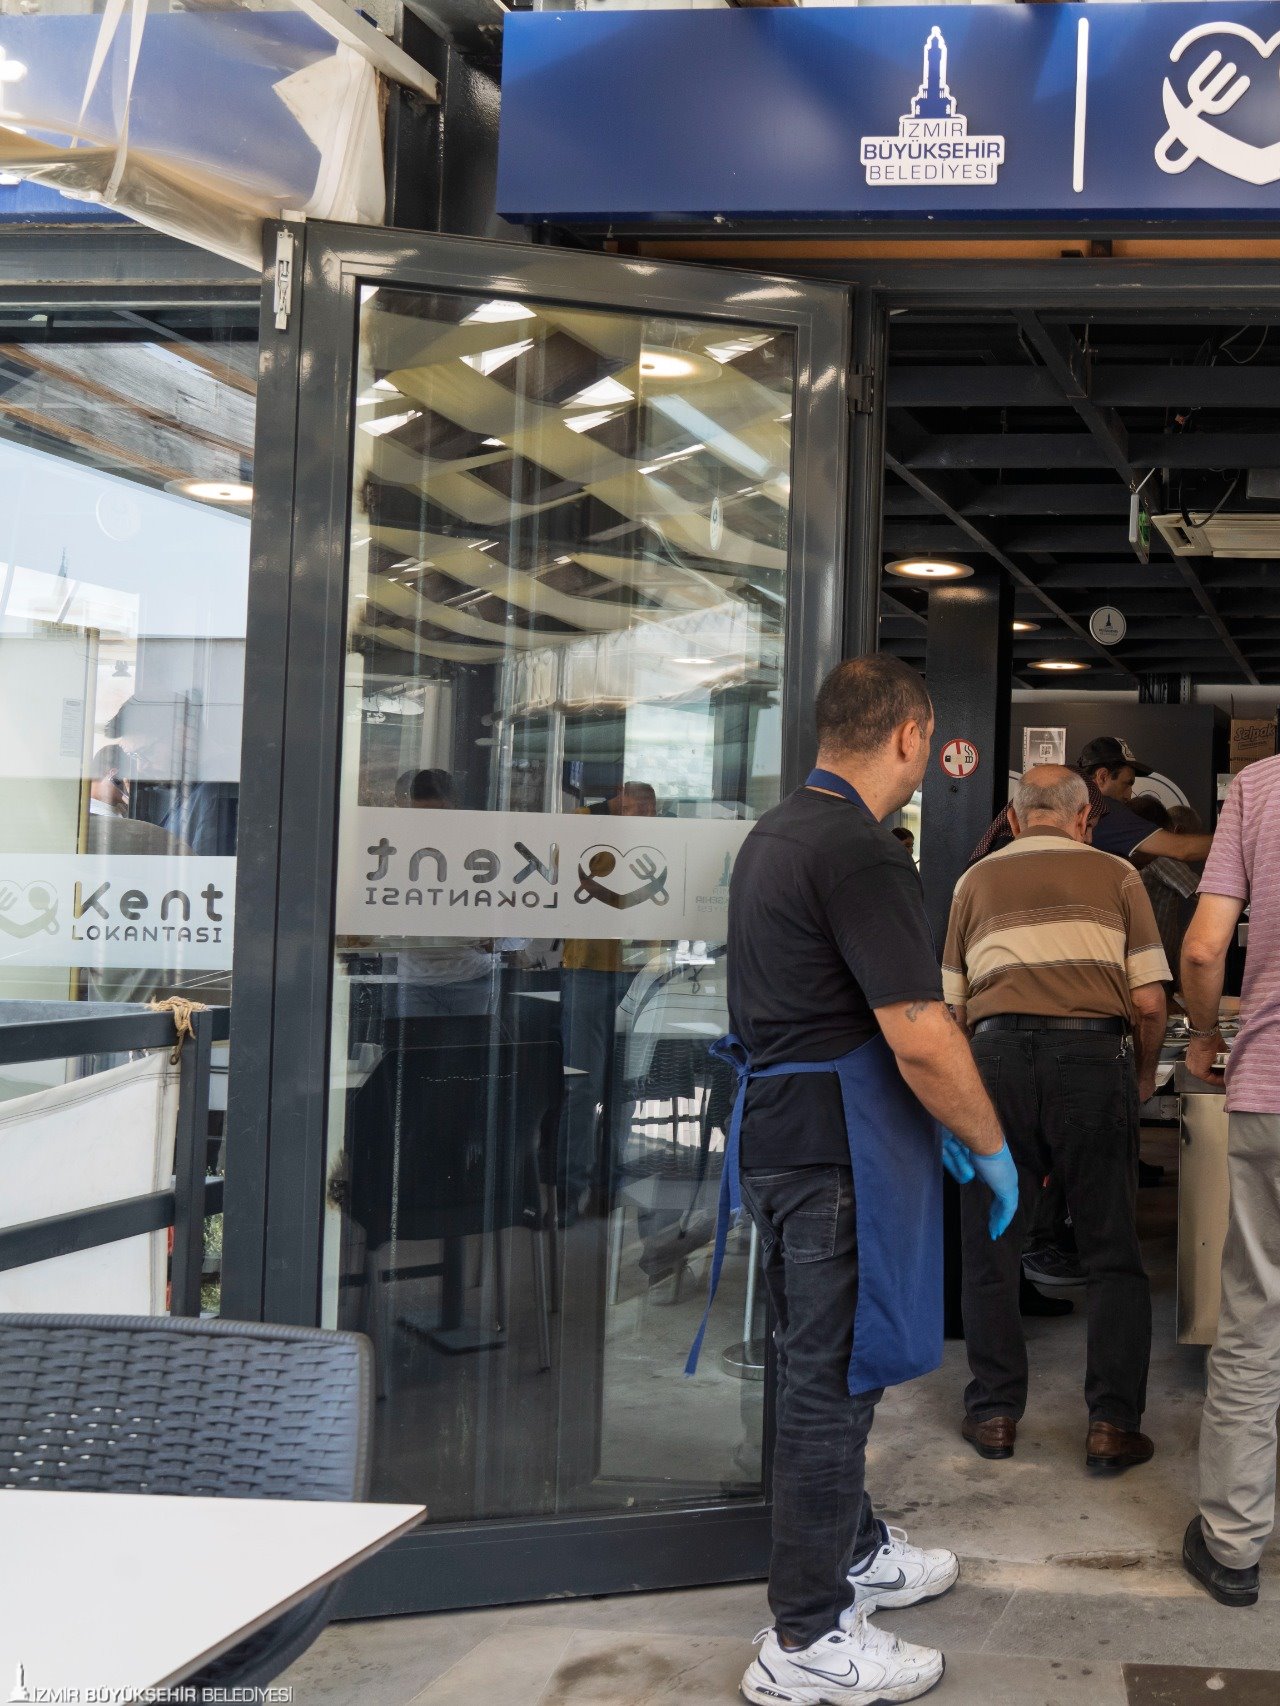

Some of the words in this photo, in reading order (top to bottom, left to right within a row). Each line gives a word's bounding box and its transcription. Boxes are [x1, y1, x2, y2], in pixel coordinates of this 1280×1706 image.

[901, 121, 963, 138] İZMİR
[864, 139, 1001, 161] BÜYÜKŞEHİR
[869, 162, 994, 180] BELEDİYESİ
[73, 881, 224, 922] Kent
[71, 924, 222, 943] LOKANTASI
